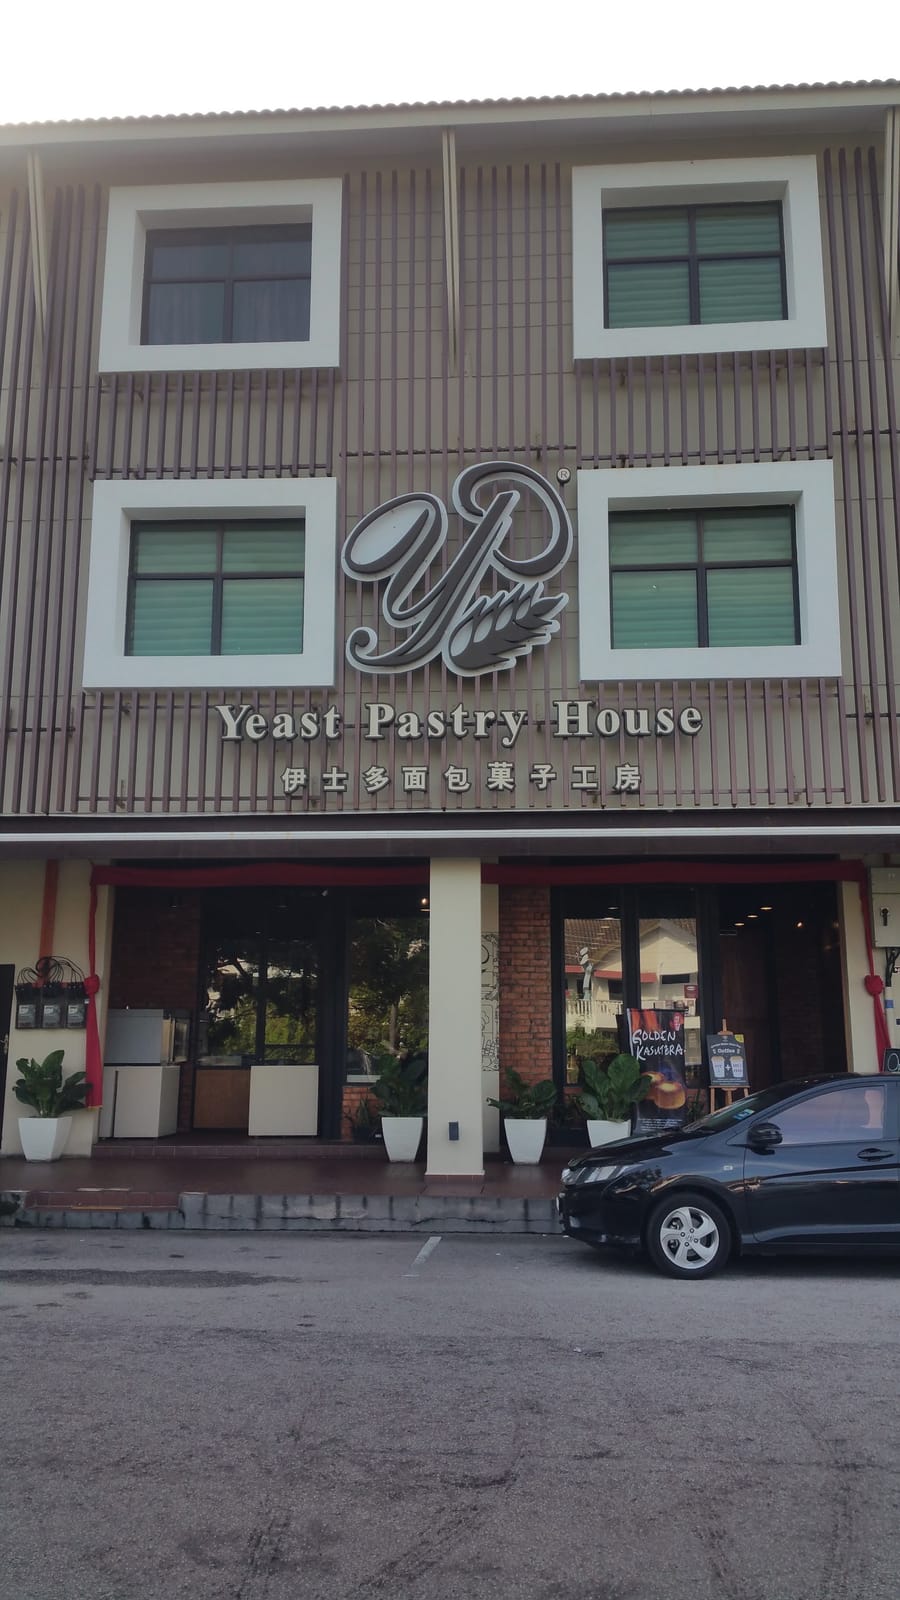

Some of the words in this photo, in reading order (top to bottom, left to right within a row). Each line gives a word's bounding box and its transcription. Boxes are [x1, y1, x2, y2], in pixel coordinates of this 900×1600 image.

[215, 703, 342, 741] Yeast
[364, 702, 528, 748] Pastry
[552, 699, 704, 738] House
[281, 761, 643, 793] 伊士多面包菓子工房
[632, 1029, 676, 1046] GOLDEN
